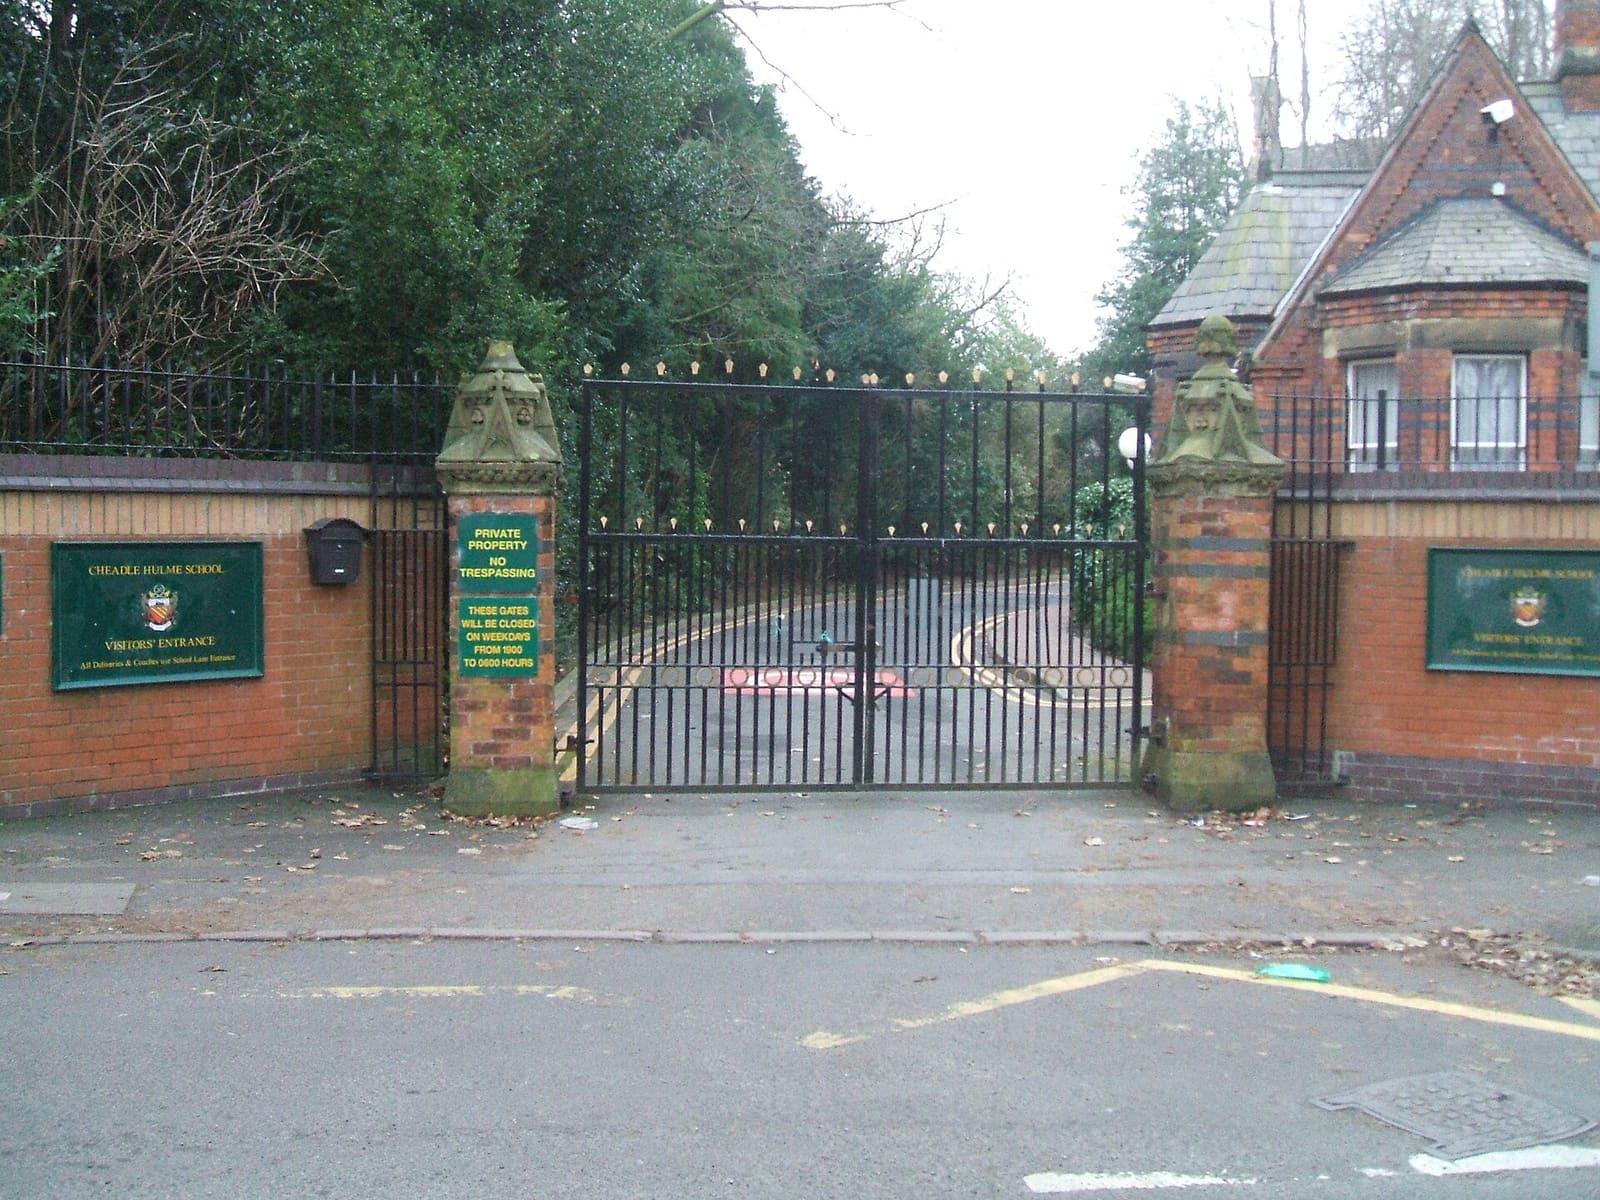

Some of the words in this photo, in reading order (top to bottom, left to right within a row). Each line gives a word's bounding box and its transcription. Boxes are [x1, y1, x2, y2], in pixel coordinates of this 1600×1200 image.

[474, 528, 521, 539] PRIVATE
[468, 540, 528, 550] PROPERTY
[489, 556, 507, 567] NO
[88, 565, 140, 576] CHEADLE
[143, 564, 182, 575] HULME
[185, 563, 224, 574] SCHOOL
[460, 568, 536, 578] TRESPASSING
[468, 606, 498, 616] THESE
[499, 606, 529, 616] GATES
[461, 620, 484, 629] WILL
[484, 620, 498, 629] BE
[499, 620, 536, 629] CLOSED
[466, 633, 481, 642] ON
[481, 632, 531, 641] WEEKDAYS
[105, 640, 157, 651] VISITORS'
[158, 636, 216, 648] ENTRANCE
[474, 646, 501, 655] FROM
[80, 662, 92, 670] All
[125, 659, 132, 667] &
[464, 659, 477, 668] TO
[501, 659, 534, 668] HOURS
